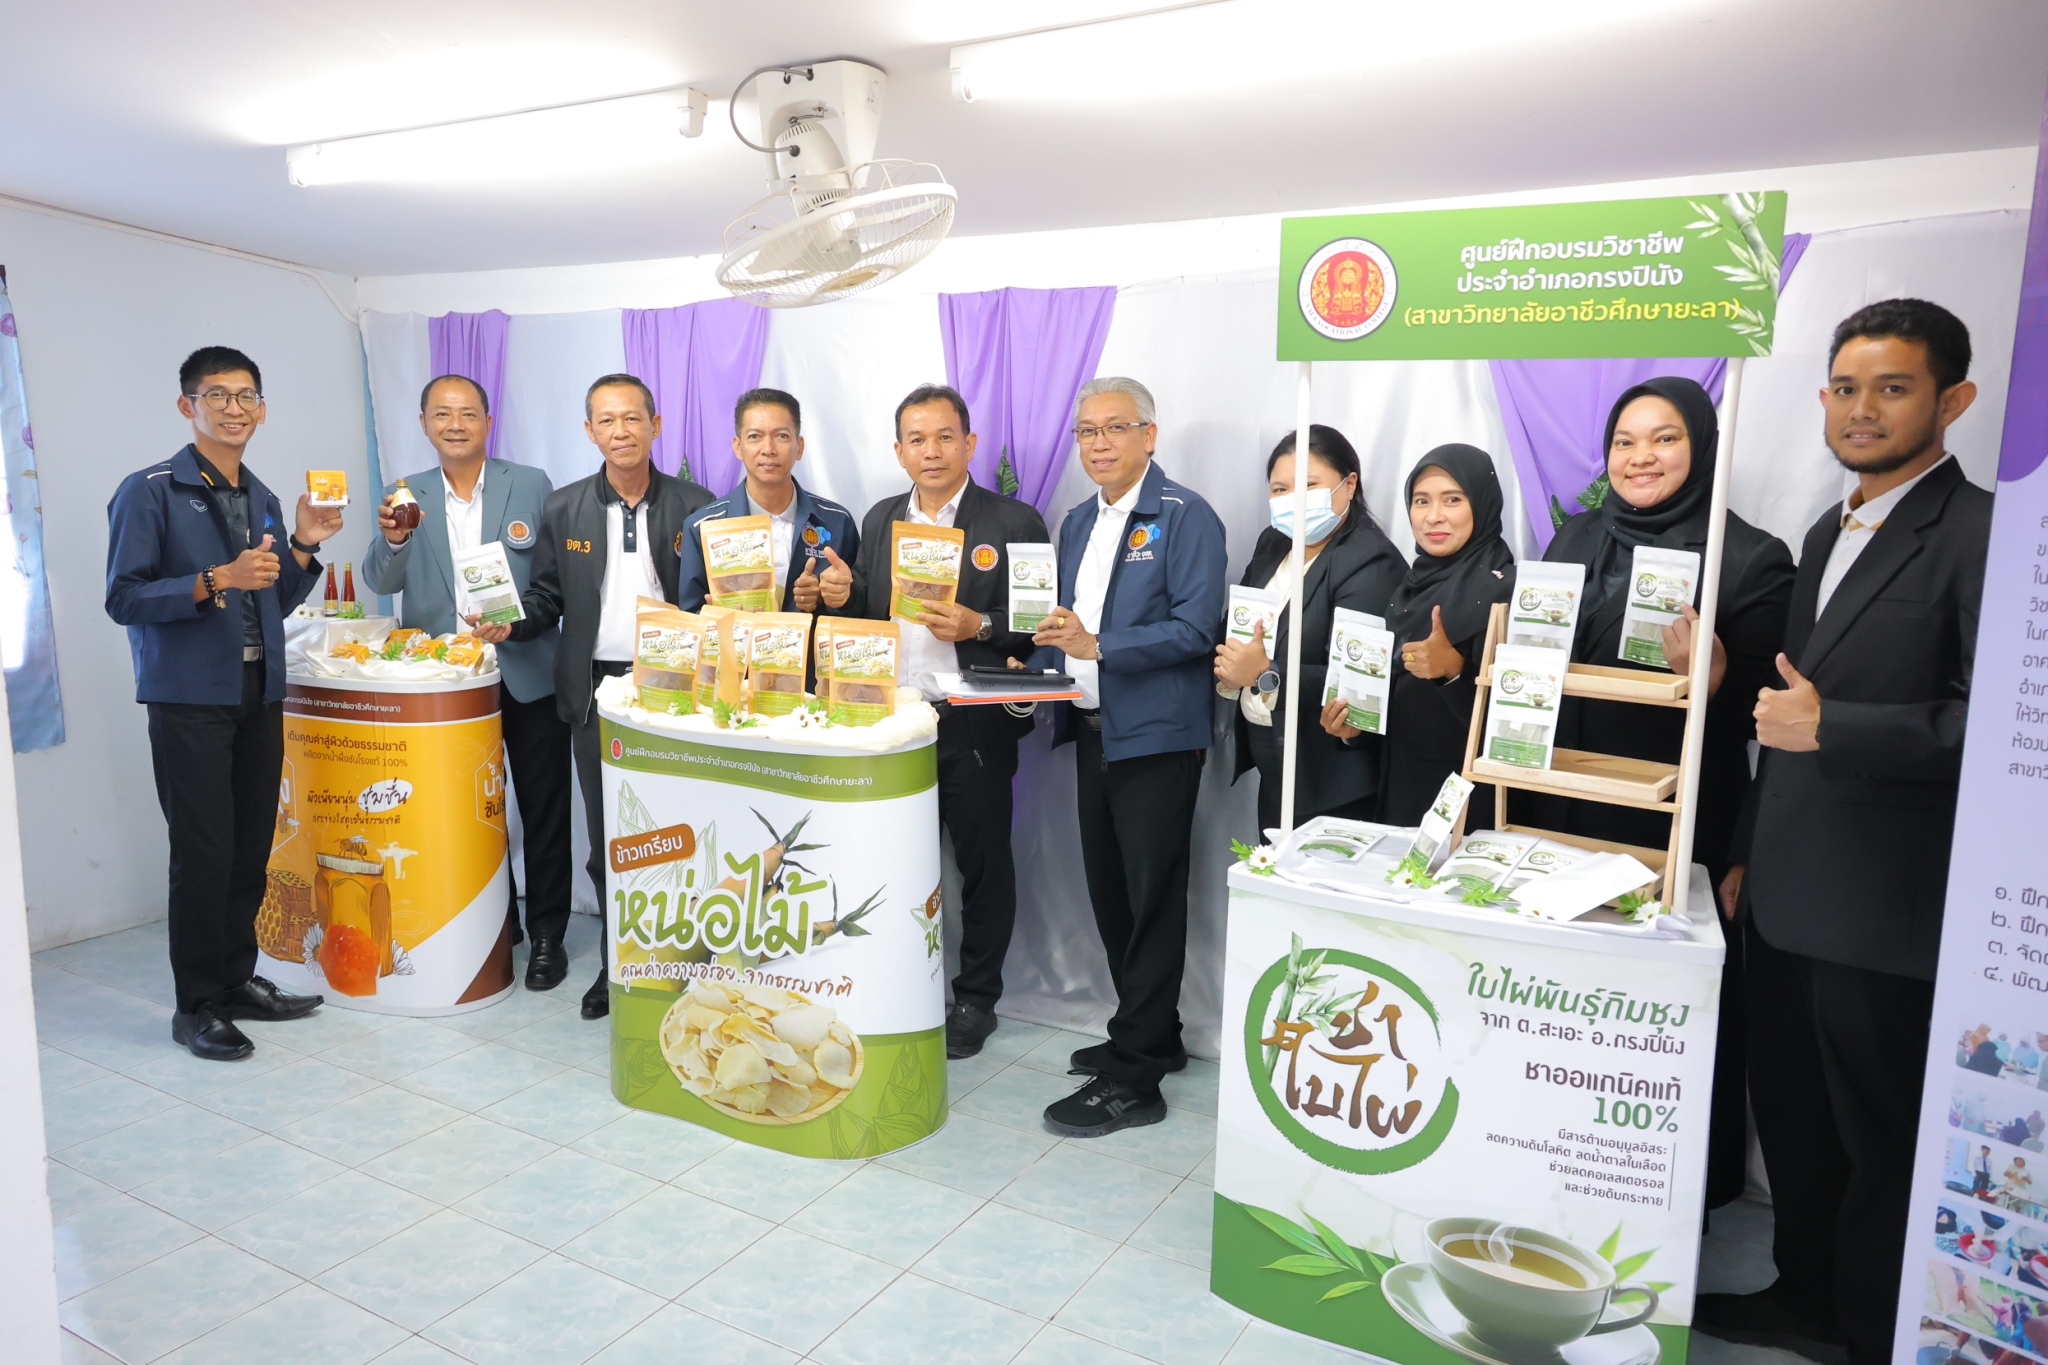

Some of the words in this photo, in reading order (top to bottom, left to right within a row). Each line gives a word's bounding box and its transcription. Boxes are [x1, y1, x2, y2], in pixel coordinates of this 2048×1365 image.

[1461, 231, 1685, 269] ศูนย์ฝึกอบรมวิชาชีพ
[1456, 263, 1684, 293] ประจำอำเภอกรงปินัง
[1404, 298, 1740, 327] (สาขาวิทยาลัยอาชีวศึกษายะลา)
[382, 758, 408, 767] 100%
[625, 747, 761, 772] ศูนย์ฝึกอบรมวิชาชีพประจำอำเภอกรงปินัง
[761, 765, 873, 786] (สาขาวิทยาลัยอาชีวศึกษายะลา)
[616, 833, 683, 864] ข้าวเกรียบ
[614, 851, 828, 955] หน่อไม้
[1468, 961, 1690, 1035] ใบไผ่พันธุ์กิมซุง
[1479, 1011, 1510, 1029] จาก
[1517, 1018, 1583, 1041] ต.สะเอะ
[1591, 1031, 1685, 1055] อ.กรงปินัง
[1525, 1061, 1681, 1101] ชาออแกนิคแท้
[1593, 1096, 1679, 1133] 100%
[1486, 1132, 1571, 1157] ลดความดันโลหิต
[1575, 1148, 1666, 1172] ลดน้ำตาลในเลือด
[1558, 1128, 1668, 1155] มีสารต้านอนุมูลอิสระ
[1549, 1161, 1665, 1189] ช่วยลดคอเลสเตอรอล
[1564, 1181, 1664, 1206] และช่วยดับกระหาย
